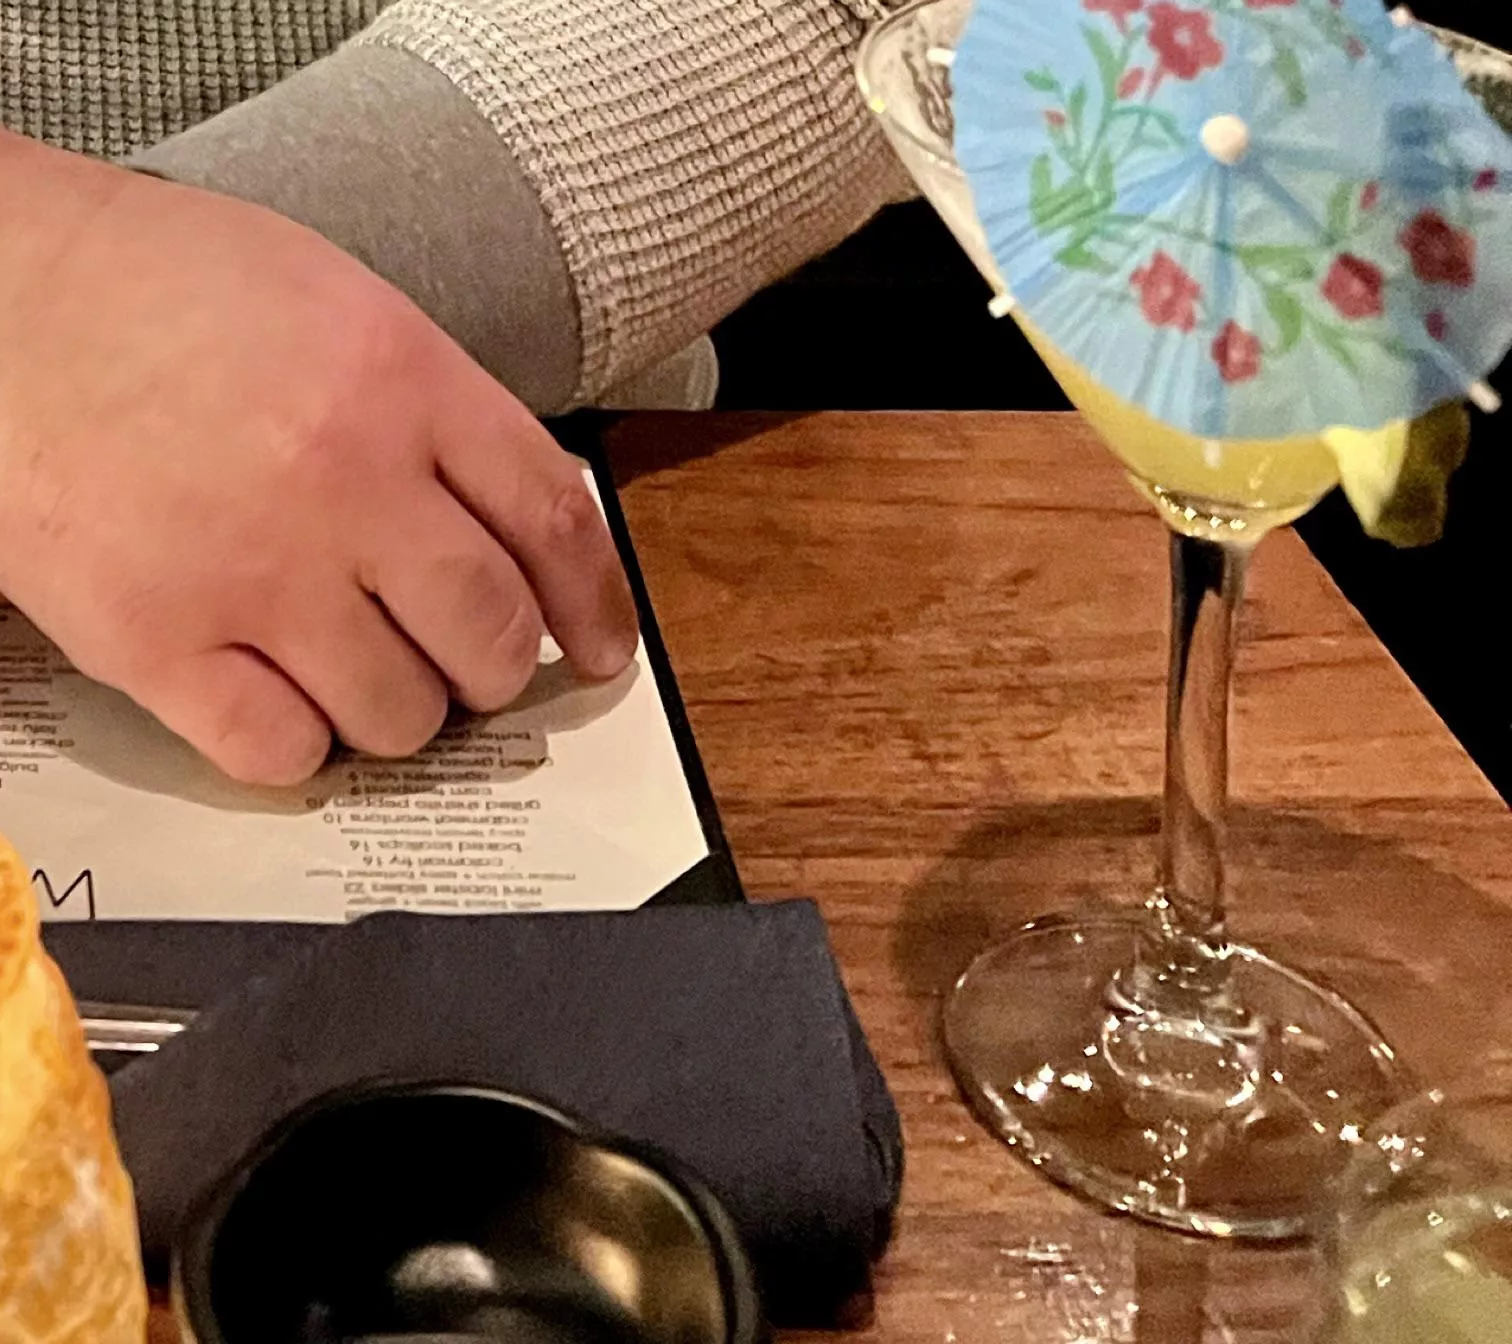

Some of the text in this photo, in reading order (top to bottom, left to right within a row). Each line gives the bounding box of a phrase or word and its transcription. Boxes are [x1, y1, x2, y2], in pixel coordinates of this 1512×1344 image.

[3, 738, 75, 749] chicken
[323, 813, 342, 825] 10
[350, 840, 369, 853] 16
[363, 855, 382, 867] 16
[389, 855, 413, 869] fry
[434, 885, 497, 897] lobster
